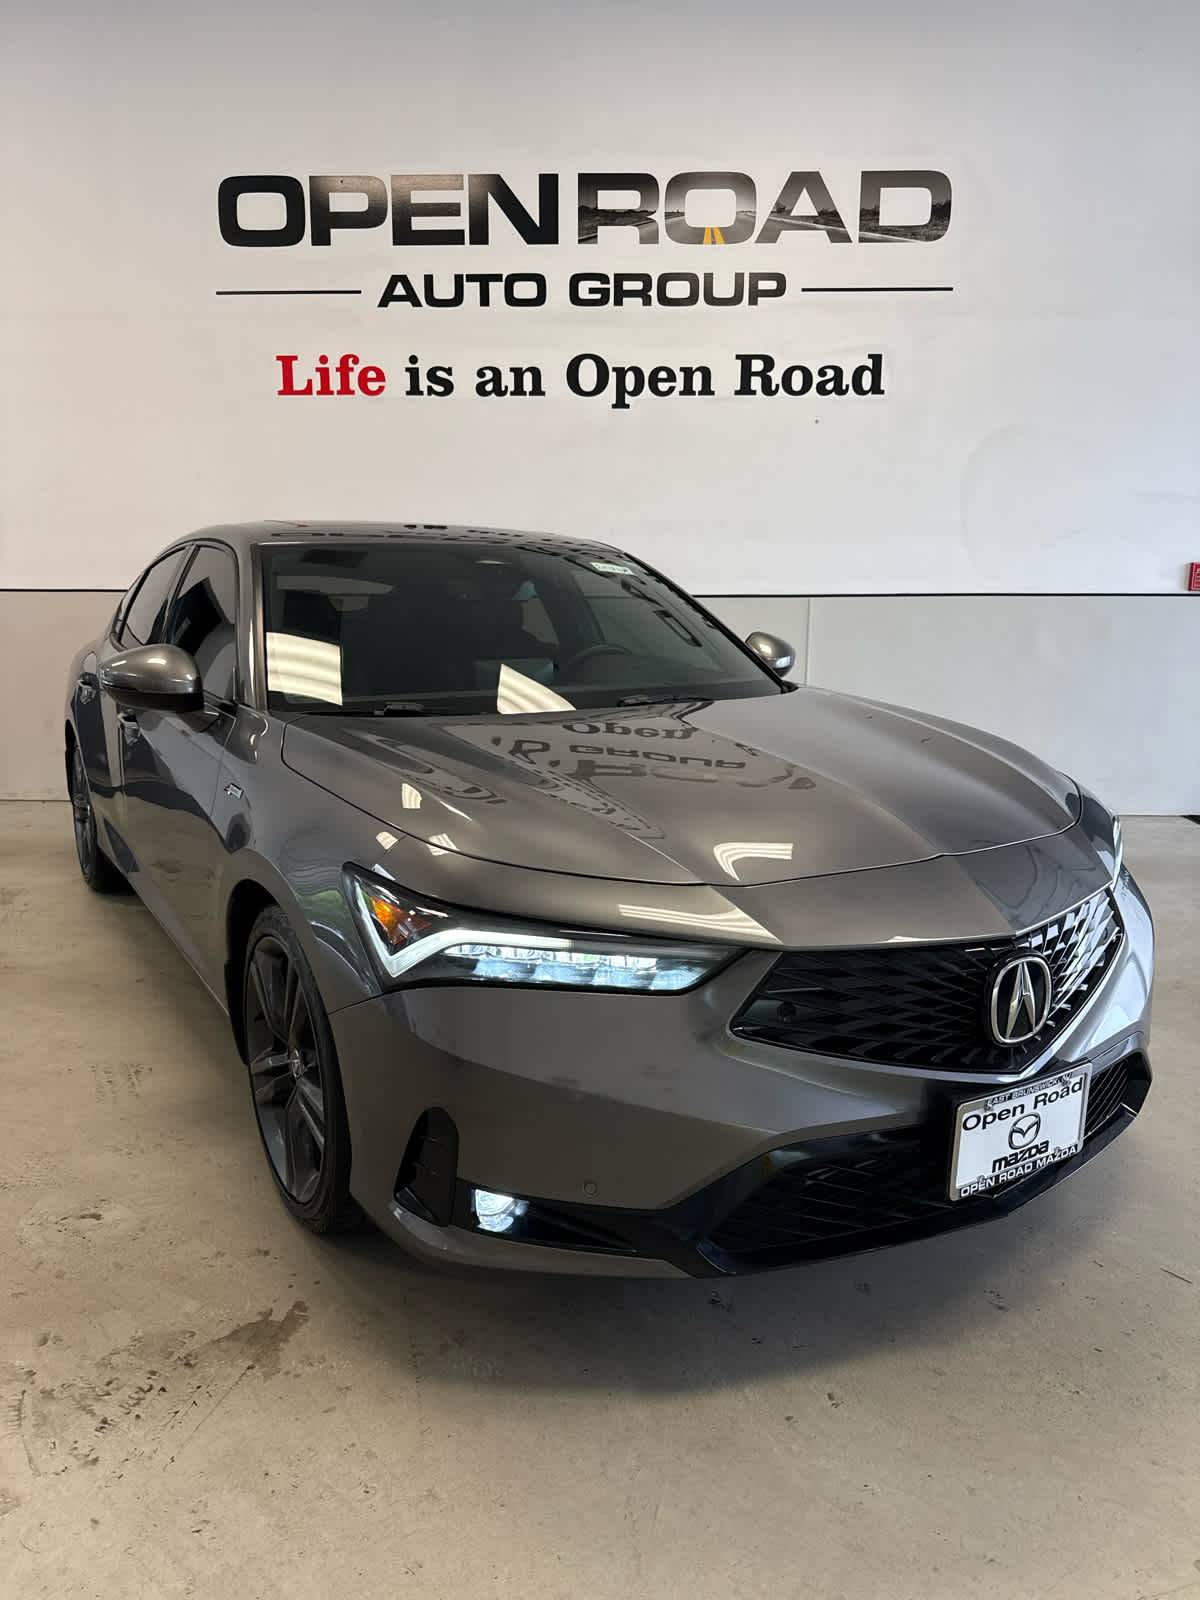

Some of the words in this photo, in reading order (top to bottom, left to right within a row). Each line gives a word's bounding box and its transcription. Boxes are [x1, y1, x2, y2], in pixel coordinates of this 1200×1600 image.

[218, 173, 559, 247] OPEN
[578, 170, 953, 244] ROAD
[377, 273, 546, 308] AUTO
[569, 272, 787, 307] GROUP
[276, 354, 387, 396] Life
[404, 355, 454, 397] is
[476, 366, 546, 397] an
[566, 354, 715, 409] Open
[734, 354, 885, 396] Road
[962, 1103, 1024, 1131] Open
[1033, 1077, 1083, 1110] Road
[960, 1176, 996, 1197] OPEN
[998, 1162, 1033, 1184] ROAD
[1036, 1144, 1077, 1168] MAZDA
[992, 1140, 1049, 1174] mazda
